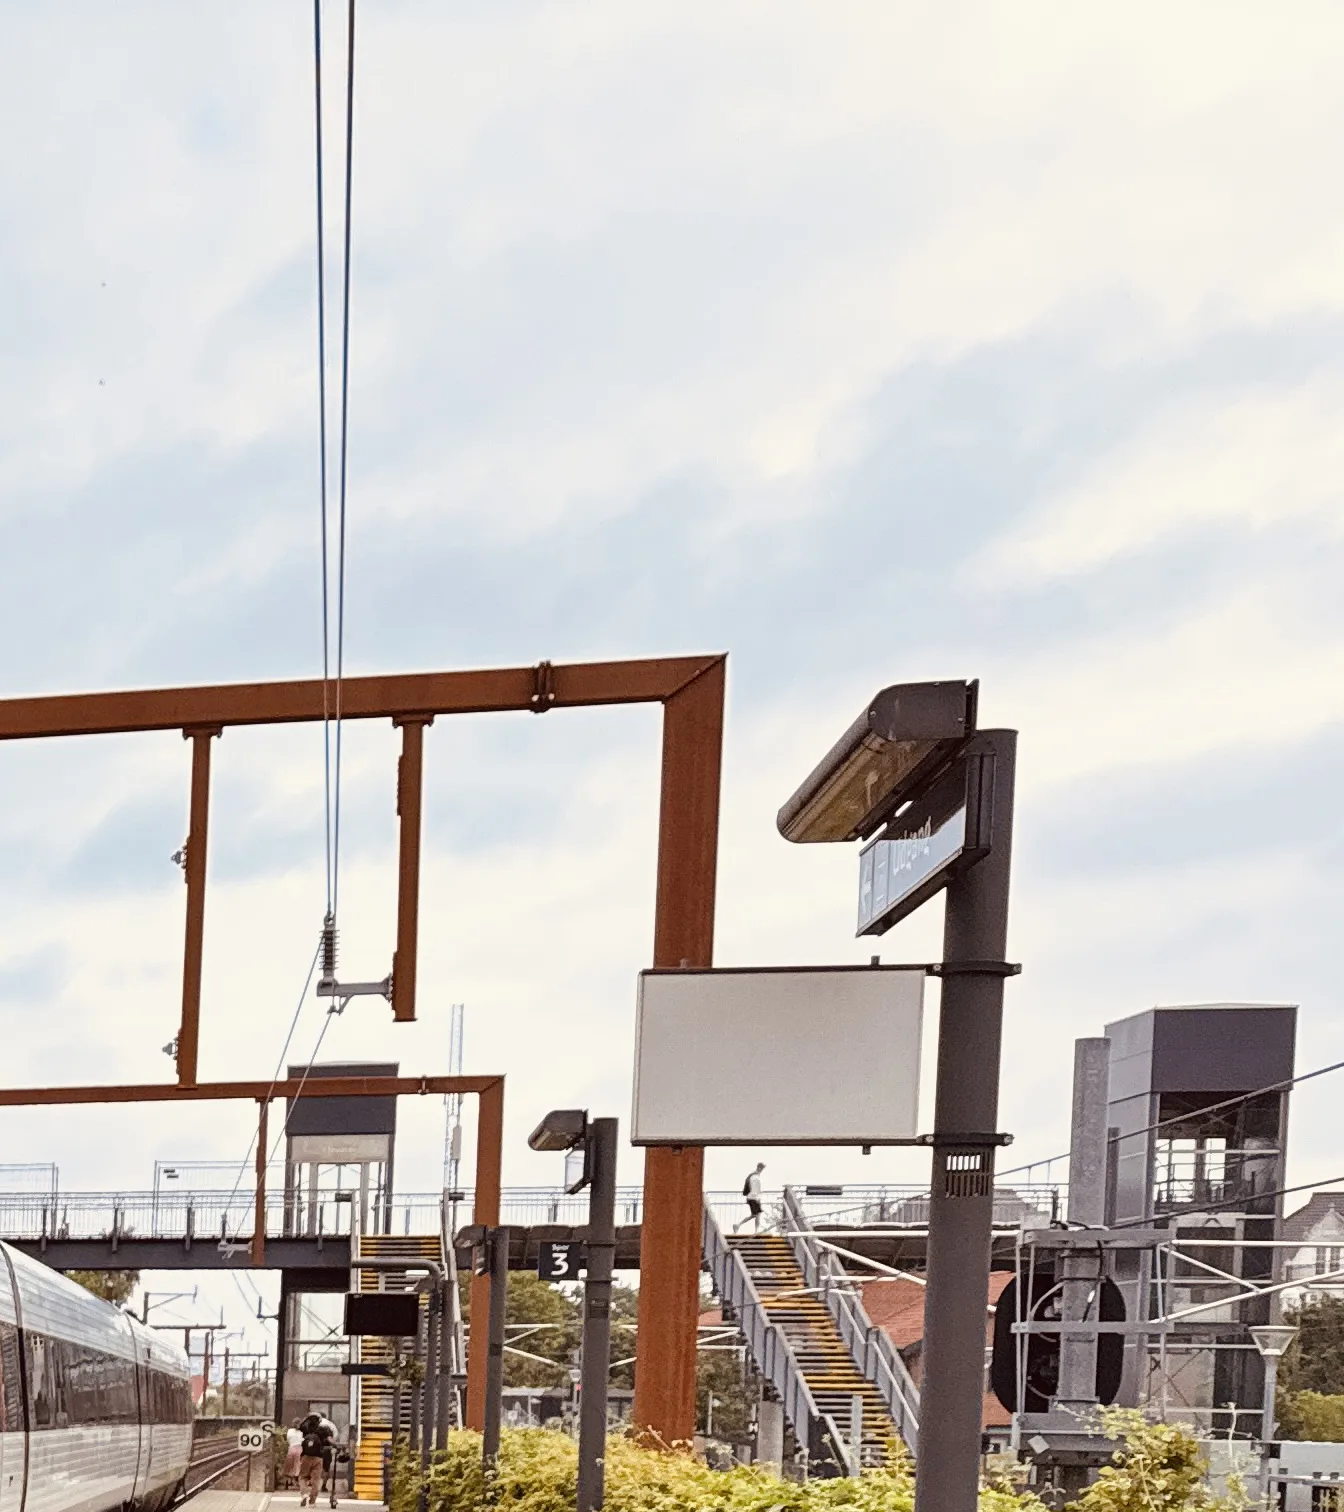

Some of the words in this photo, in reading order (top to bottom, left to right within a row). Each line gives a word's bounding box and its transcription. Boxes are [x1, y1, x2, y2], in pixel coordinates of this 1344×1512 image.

[550, 1252, 569, 1276] 3
[240, 1433, 262, 1447] 90
[261, 1423, 275, 1440] S
